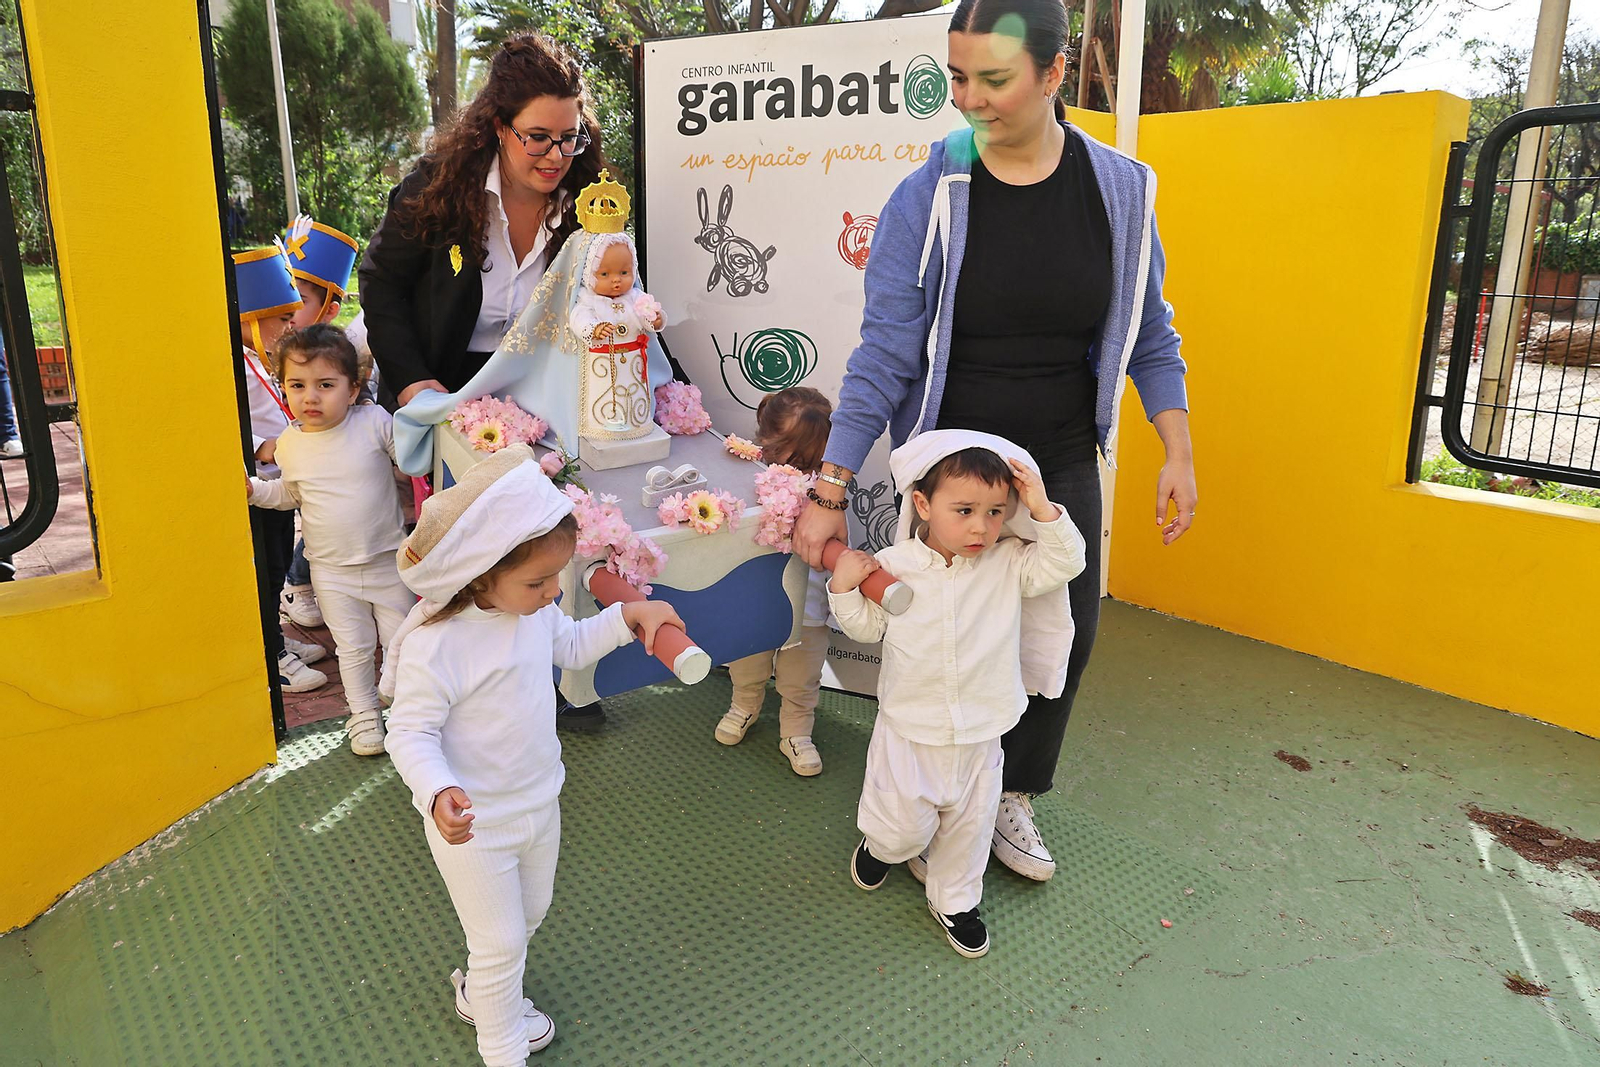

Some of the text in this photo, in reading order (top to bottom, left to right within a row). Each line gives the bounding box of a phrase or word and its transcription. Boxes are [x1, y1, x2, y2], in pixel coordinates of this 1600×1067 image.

[681, 61, 775, 79] CENTRO INFANTIL
[677, 54, 957, 137] garabato
[680, 143, 930, 183] un espacio para cre
